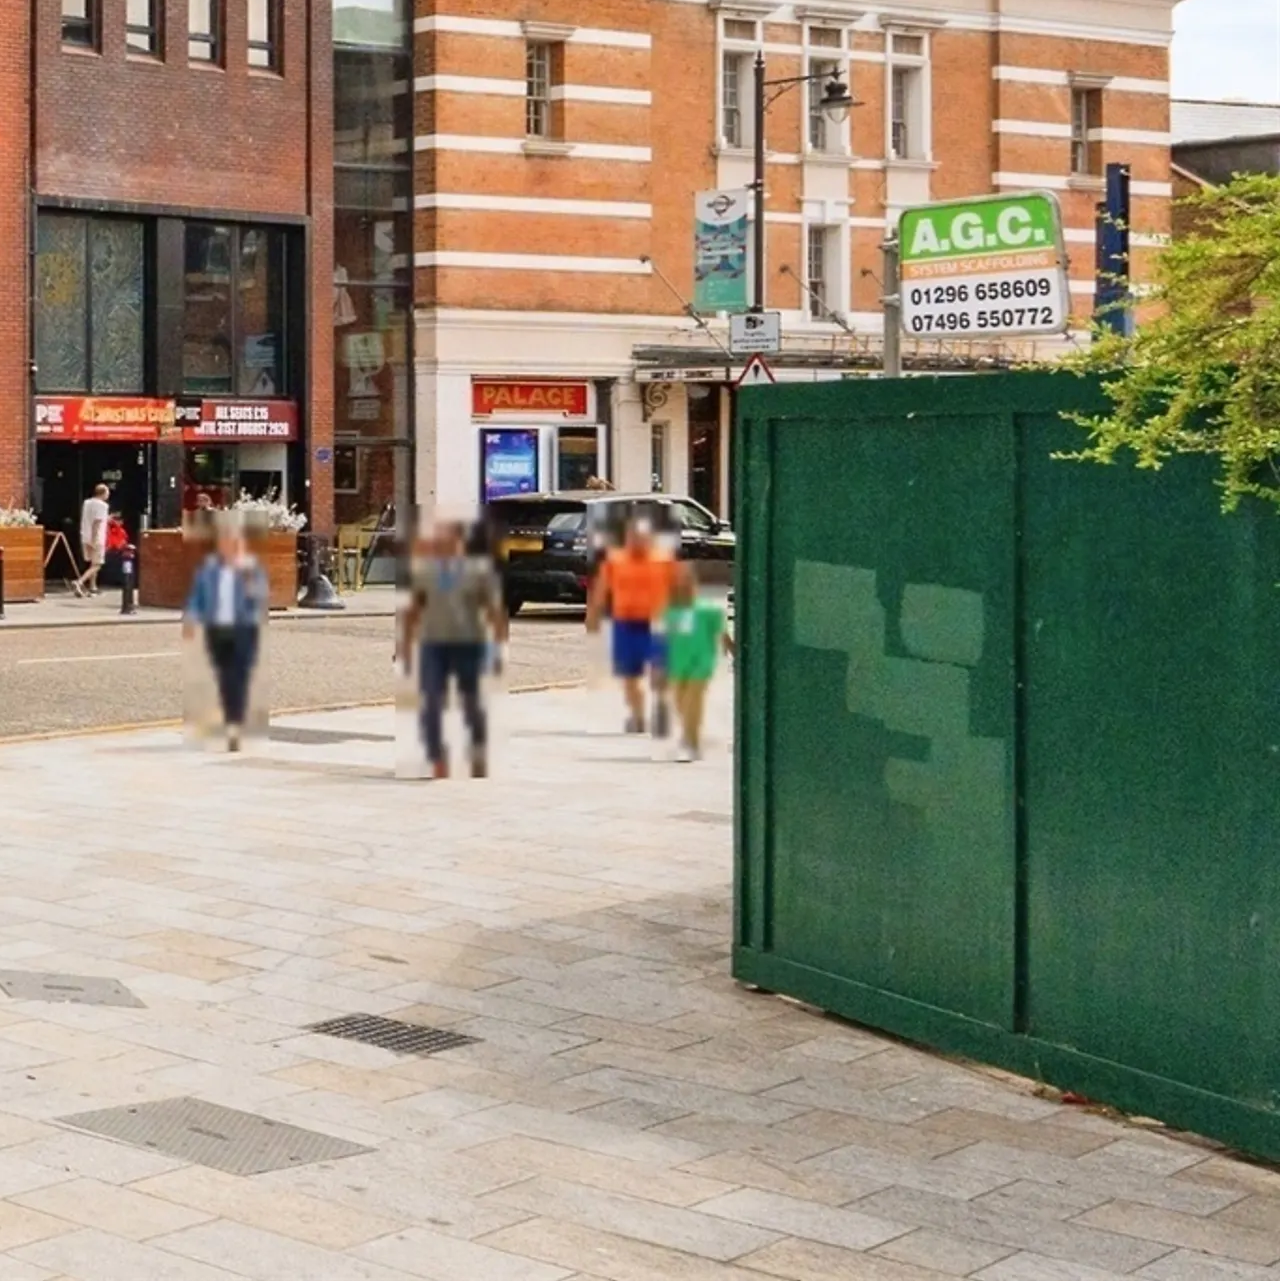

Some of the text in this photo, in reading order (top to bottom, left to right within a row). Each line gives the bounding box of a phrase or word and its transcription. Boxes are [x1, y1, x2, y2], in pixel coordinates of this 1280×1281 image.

[909, 205, 1046, 255] A.G.C.
[910, 253, 1049, 276] SYSTEM SCAFFOLDING
[910, 277, 1051, 306] 01296 658609
[911, 306, 1054, 332] 07496 550772
[482, 386, 576, 406] PALACE
